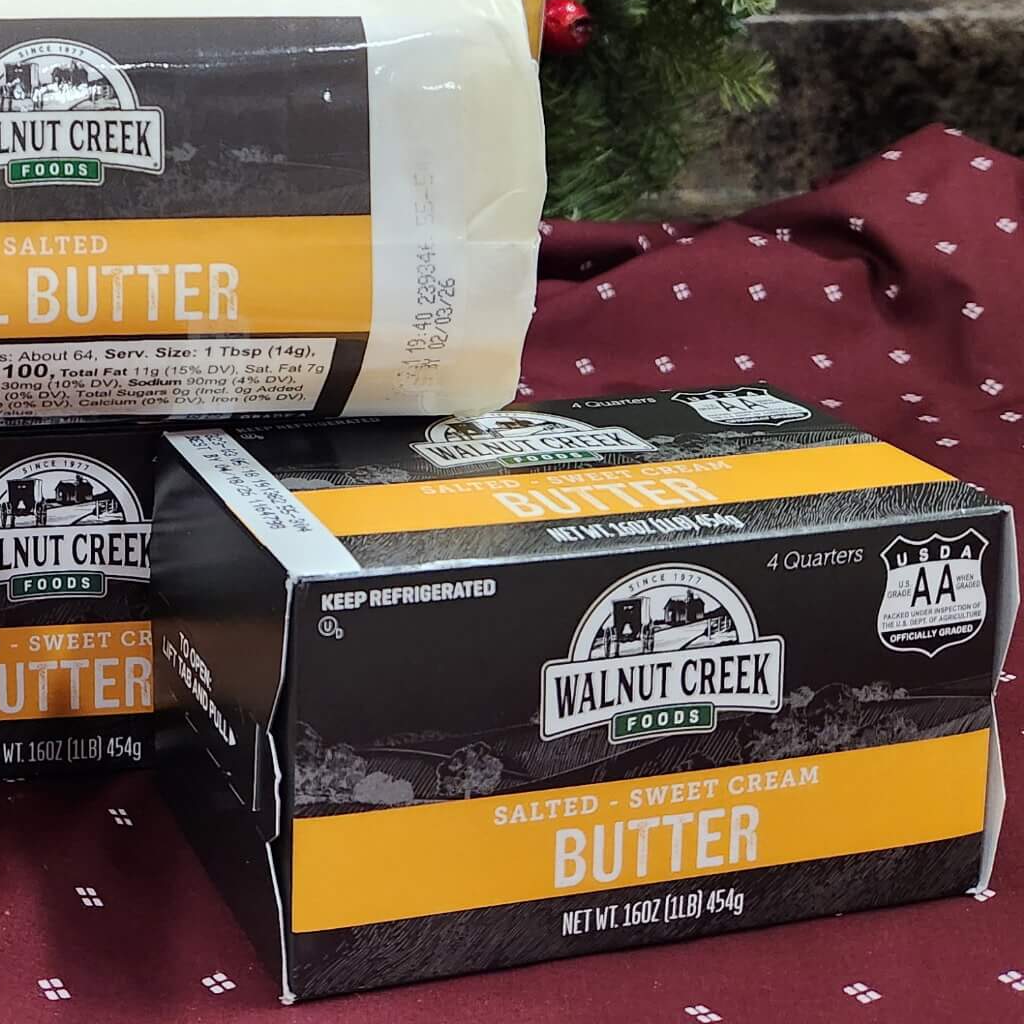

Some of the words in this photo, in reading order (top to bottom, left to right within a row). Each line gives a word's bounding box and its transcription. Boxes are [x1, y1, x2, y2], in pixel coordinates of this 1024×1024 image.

[68, 119, 151, 157] CREEK
[21, 163, 89, 177] FOODS
[3, 236, 108, 256] SALTED
[26, 262, 240, 325] BUTTER
[18, 351, 67, 362] About
[104, 348, 148, 360] Serv.
[155, 347, 197, 358] Size:
[220, 346, 261, 359] Tbsp
[492, 478, 718, 519] BUTTER
[72, 531, 152, 569] CREEK
[766, 553, 779, 571] 4
[784, 547, 863, 570] Quarters
[23, 577, 91, 592] FOODS
[321, 592, 367, 611] KEEP
[369, 579, 496, 608] REFRIGERATED
[911, 563, 956, 607] AA
[29, 632, 111, 652] SWEET
[179, 632, 189, 658] TO
[890, 629, 937, 643] OFFICIALLY
[939, 624, 973, 637] GRADED
[178, 656, 191, 688] TAB
[192, 678, 208, 711] AND
[209, 699, 229, 742] PULL
[555, 659, 673, 720] WALNUT
[680, 653, 770, 702] CREEK
[626, 708, 700, 732] FOODS
[3, 742, 25, 765] WT.
[67, 735, 102, 763] (1LB)
[107, 736, 141, 761] 454g
[493, 795, 599, 827] SALTED
[629, 778, 719, 810] SWEET
[728, 766, 820, 796] CREAM
[553, 804, 760, 889] BUTTER
[562, 909, 590, 936] NET
[595, 904, 618, 932] WT.
[664, 889, 703, 924] (1LB)
[706, 888, 744, 917] 454g
